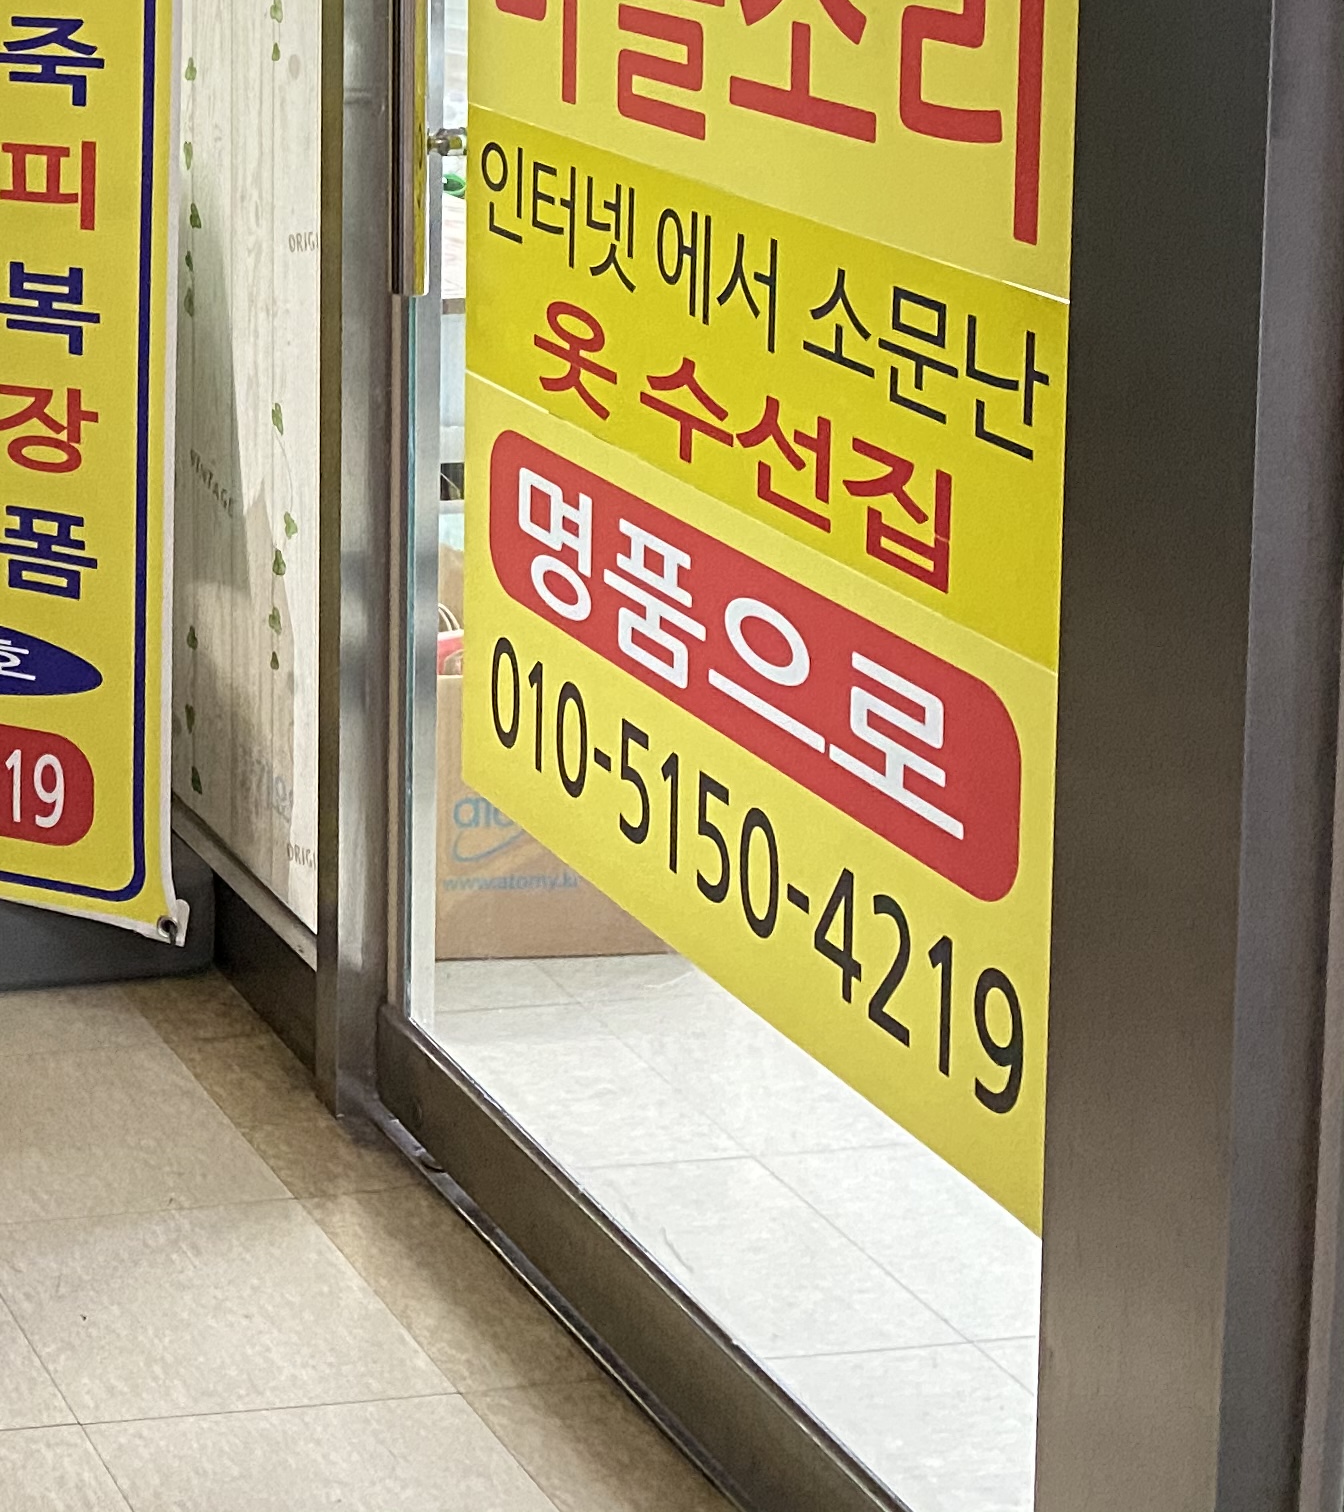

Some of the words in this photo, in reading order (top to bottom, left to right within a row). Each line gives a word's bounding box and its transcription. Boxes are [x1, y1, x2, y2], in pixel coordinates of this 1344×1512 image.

[480, 140, 637, 294] 인터넷
[656, 207, 778, 354] 에서
[802, 267, 1050, 462] 소문난
[533, 300, 618, 420] 옷
[639, 356, 954, 594] 수선집
[517, 465, 965, 841] 명품으로
[490, 636, 1025, 1115] 010-5150-4219
